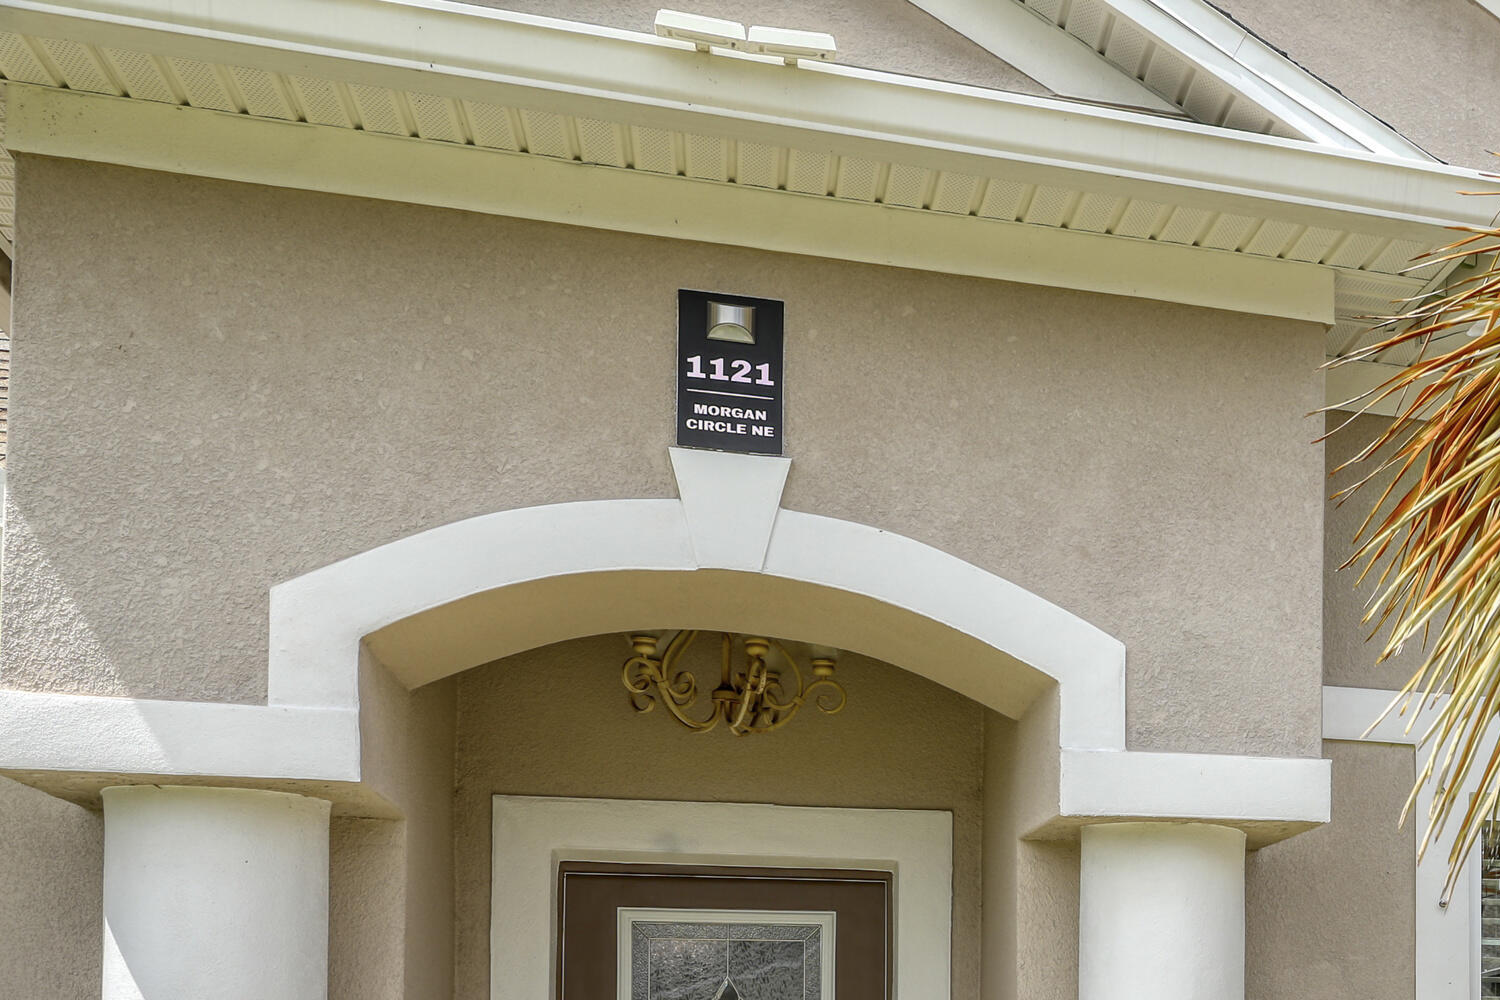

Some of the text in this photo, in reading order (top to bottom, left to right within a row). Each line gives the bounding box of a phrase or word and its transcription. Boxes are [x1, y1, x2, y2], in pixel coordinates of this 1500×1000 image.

[686, 355, 775, 387] 1121
[693, 403, 767, 421] MORGAN
[685, 418, 775, 437] CIRCLE NE
